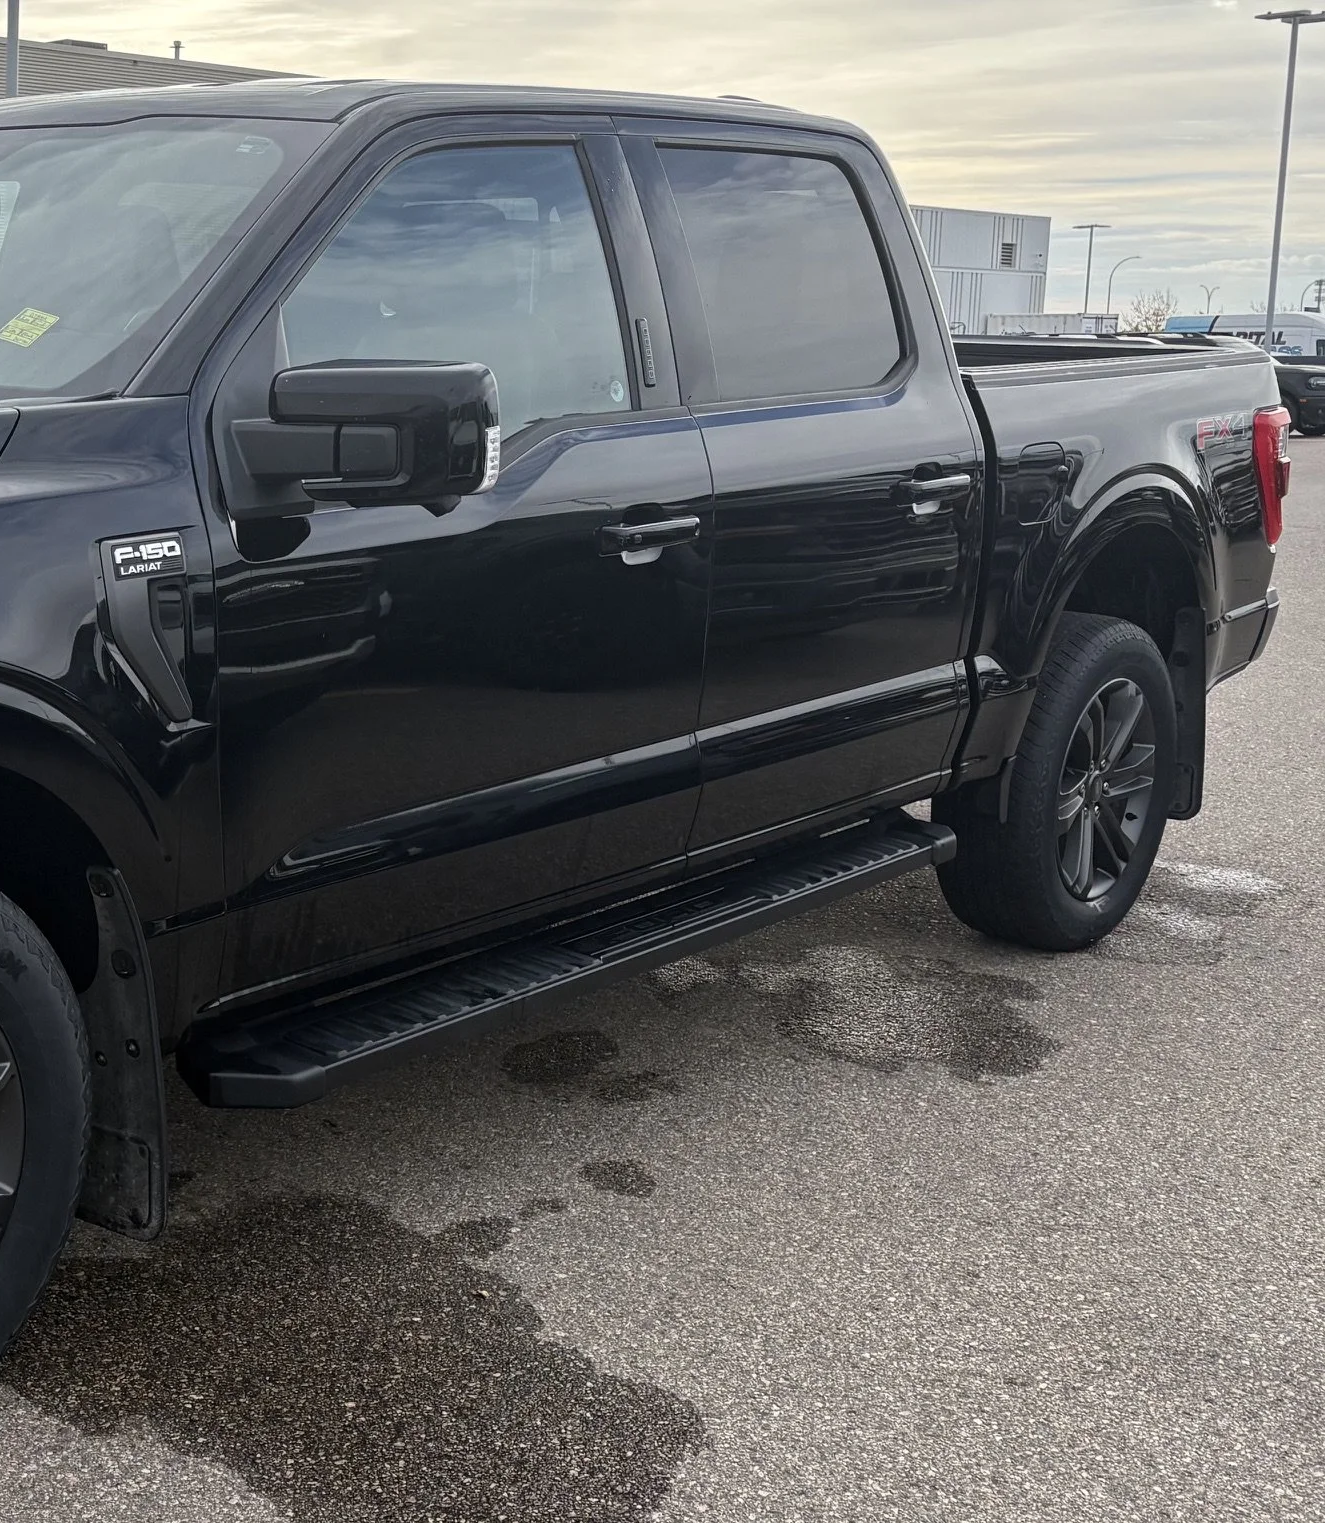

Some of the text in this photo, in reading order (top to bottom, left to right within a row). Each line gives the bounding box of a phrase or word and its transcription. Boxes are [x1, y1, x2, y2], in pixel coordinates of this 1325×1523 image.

[1196, 412, 1248, 453] FX4
[114, 540, 181, 564] F-150
[120, 561, 163, 576] LARIAT
